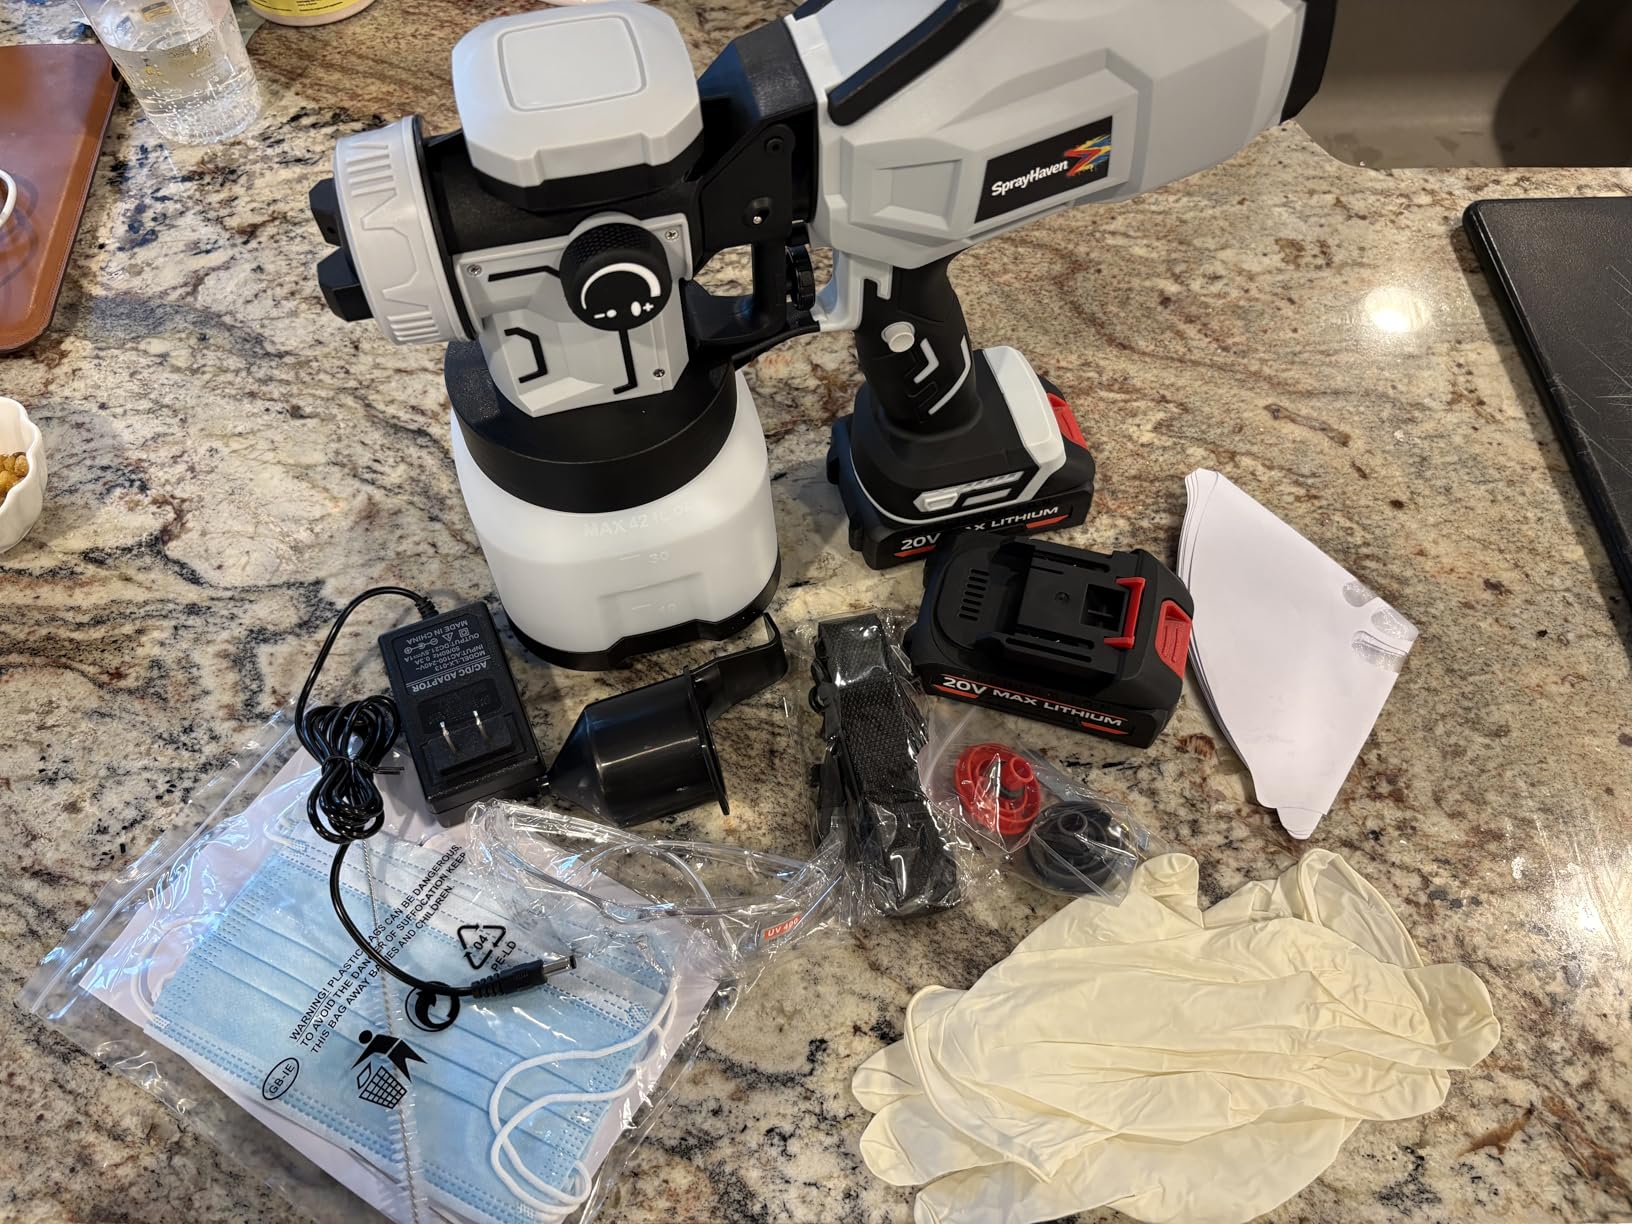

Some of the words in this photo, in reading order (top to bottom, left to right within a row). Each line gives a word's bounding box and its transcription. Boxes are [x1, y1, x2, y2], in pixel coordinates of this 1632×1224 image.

[991, 160, 1068, 196] SprayHaven
[901, 533, 941, 550] 20V
[991, 506, 1059, 528] LITHIUM
[406, 631, 433, 645] CHINA
[434, 628, 443, 636] IN
[444, 620, 469, 632] MADE
[411, 671, 457, 693] ADAPTOR
[458, 661, 487, 677] AC/DC
[942, 676, 988, 695] 20V
[992, 689, 1038, 706] MAX
[1043, 702, 1122, 727] LITHIUM
[289, 987, 330, 1040] WARNING!
[327, 948, 363, 988] PLASTIC
[367, 924, 386, 946] AGS
[384, 907, 403, 925] CAN
[401, 894, 415, 909] BE
[412, 844, 462, 896] DANGEROUS,
[473, 934, 489, 950] 04
[767, 926, 782, 937] UV
[783, 917, 799, 930] 400
[300, 1032, 314, 1047] TO
[312, 998, 336, 1032] AVOID
[333, 979, 353, 999] THE
[351, 941, 387, 979] DANER
[385, 929, 397, 942] OF
[396, 873, 448, 931] SUFFOCATION
[446, 852, 466, 874] KEEP
[491, 941, 516, 972] PE-LD
[310, 1029, 330, 1053] THIS
[328, 1004, 347, 1029] BAG
[346, 977, 370, 1006] AWAY
[368, 946, 400, 978] BAIES
[398, 929, 417, 948] AND
[415, 885, 455, 929] CHILDREN.
[269, 1063, 295, 1094] GB-IE
